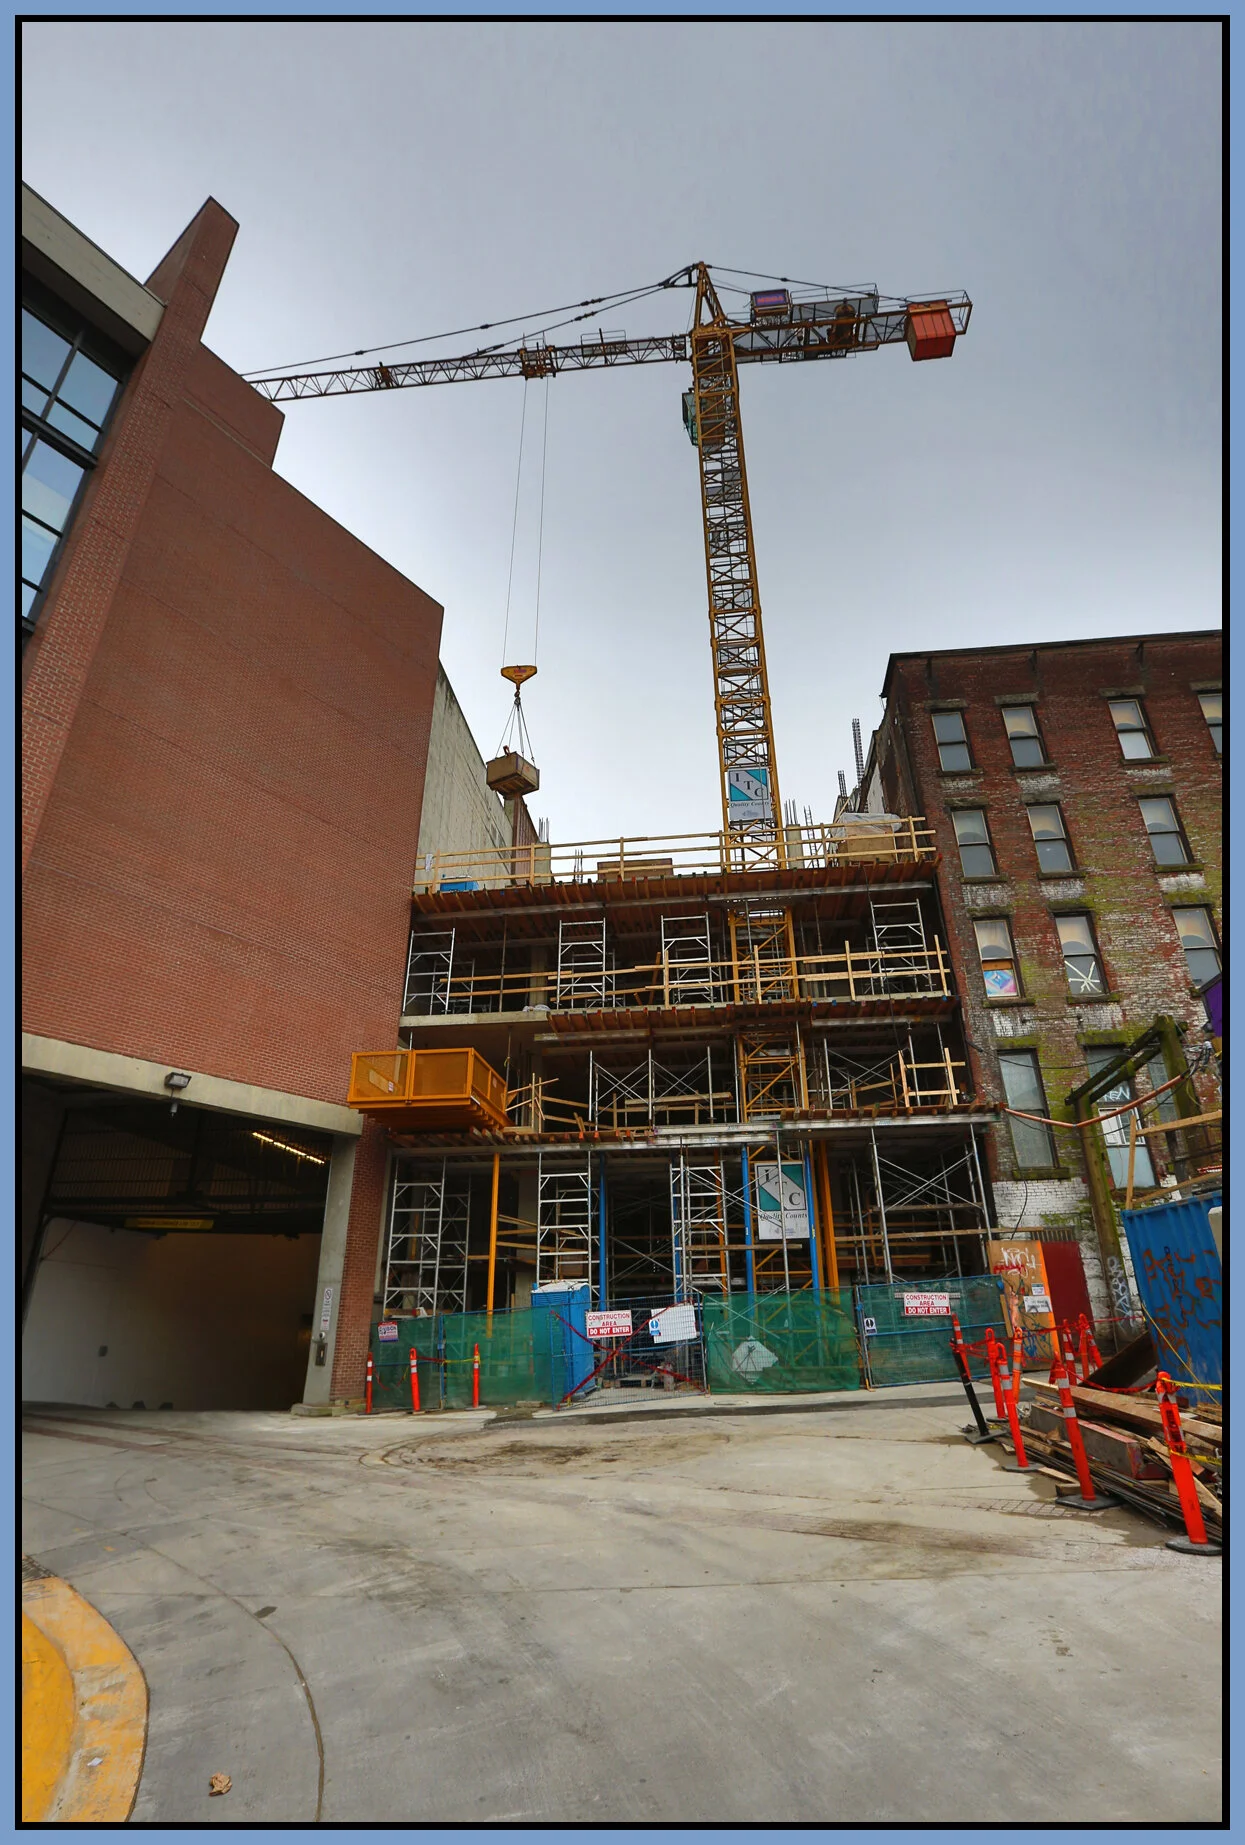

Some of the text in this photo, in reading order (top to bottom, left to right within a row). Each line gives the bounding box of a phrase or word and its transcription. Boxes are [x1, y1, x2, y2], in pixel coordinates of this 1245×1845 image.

[735, 772, 764, 797] ITC
[764, 1168, 801, 1206] ITC
[760, 1212, 784, 1221] Qualit
[929, 1306, 947, 1314] ENTER
[588, 1313, 630, 1321] CONSTRUCTION
